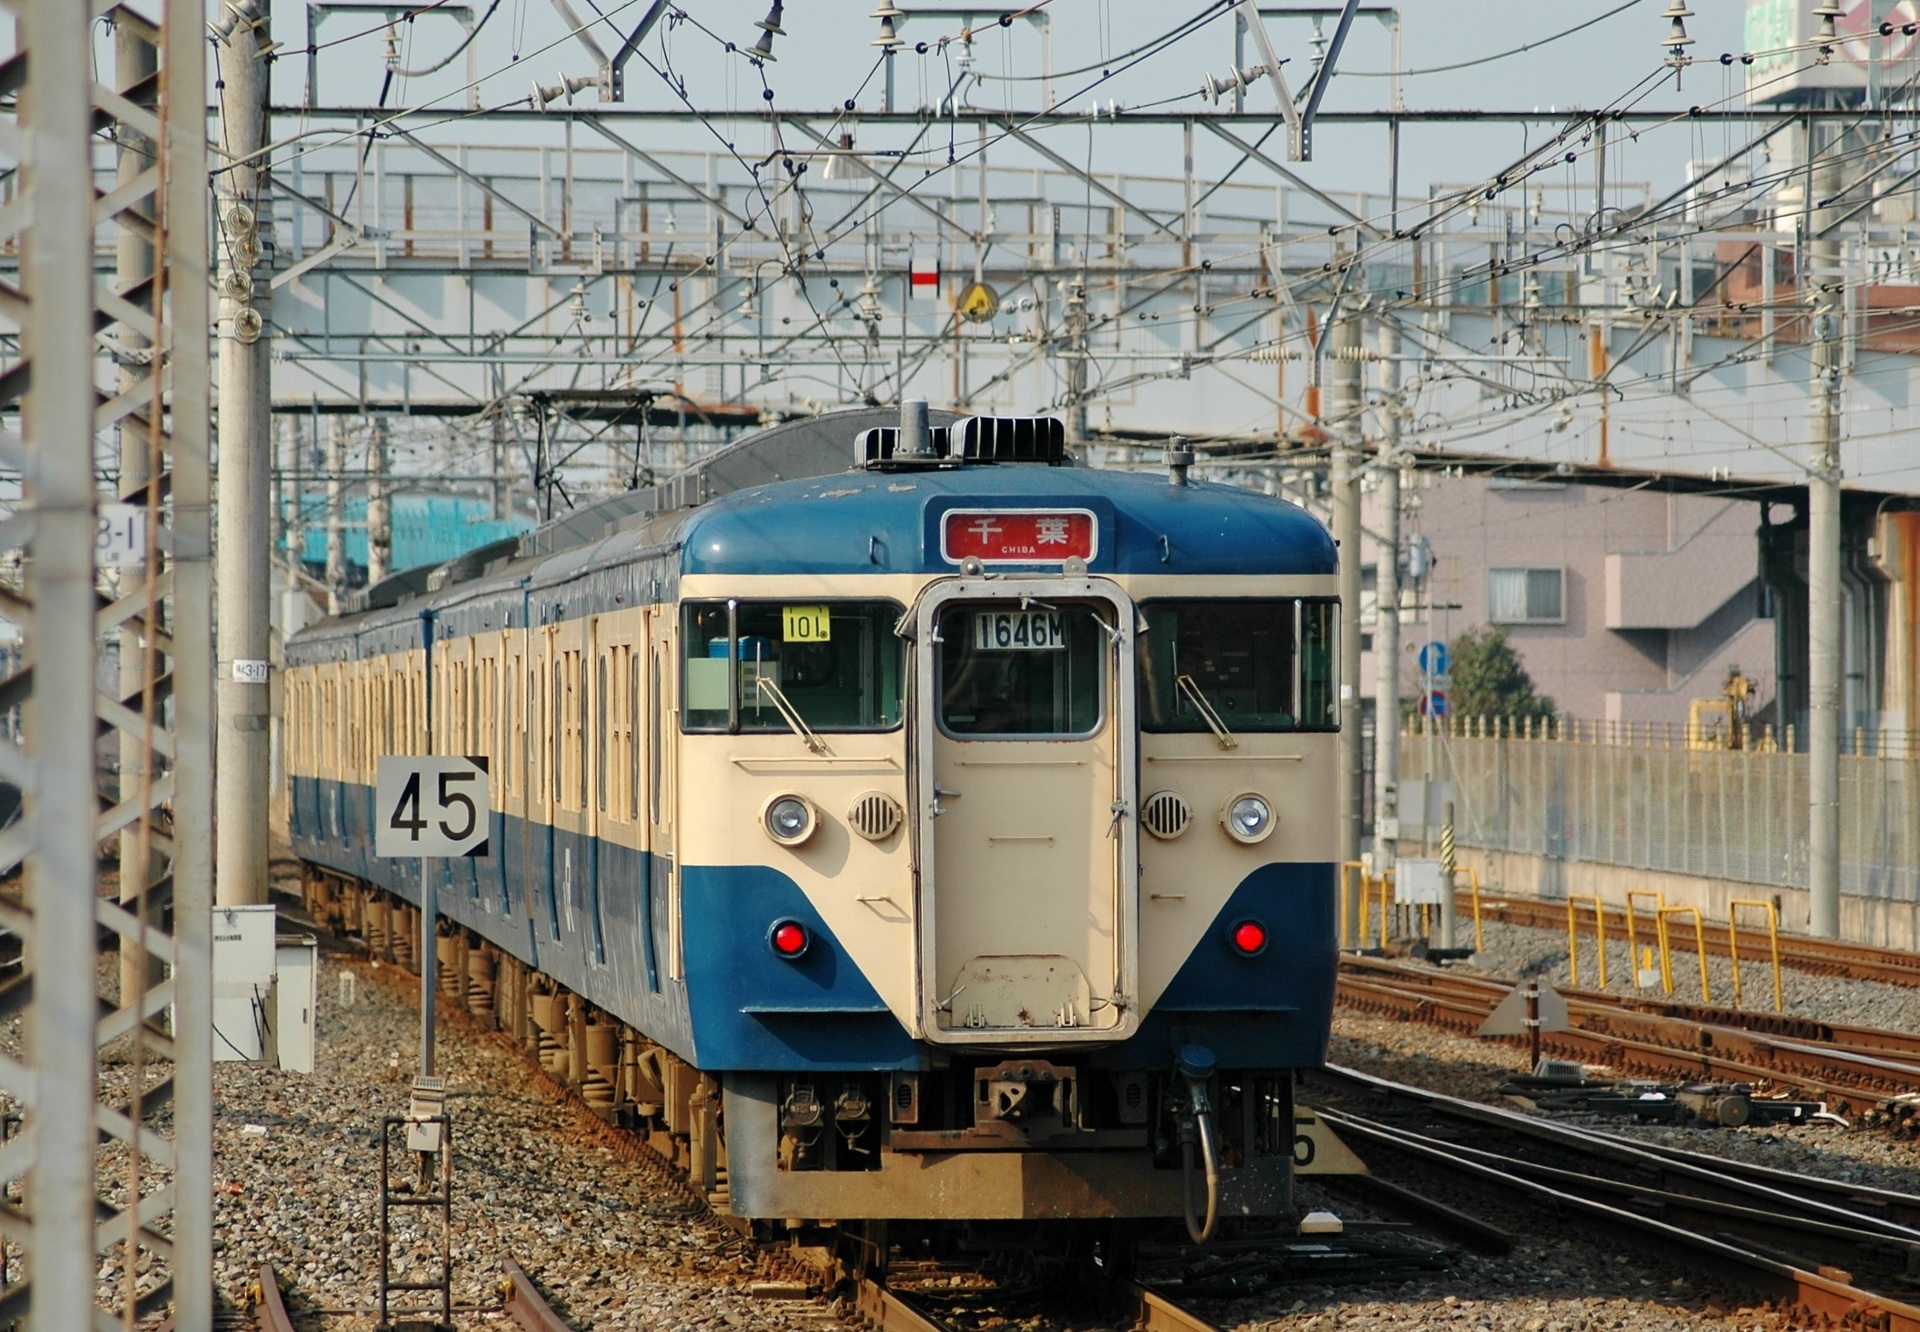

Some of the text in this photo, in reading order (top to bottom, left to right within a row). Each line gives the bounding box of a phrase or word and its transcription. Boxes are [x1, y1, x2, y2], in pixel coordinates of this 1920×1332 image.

[968, 517, 1070, 545] 千葉
[1001, 546, 1036, 554] CHIBA
[981, 613, 1065, 648] 1646M
[390, 771, 476, 841] 45
